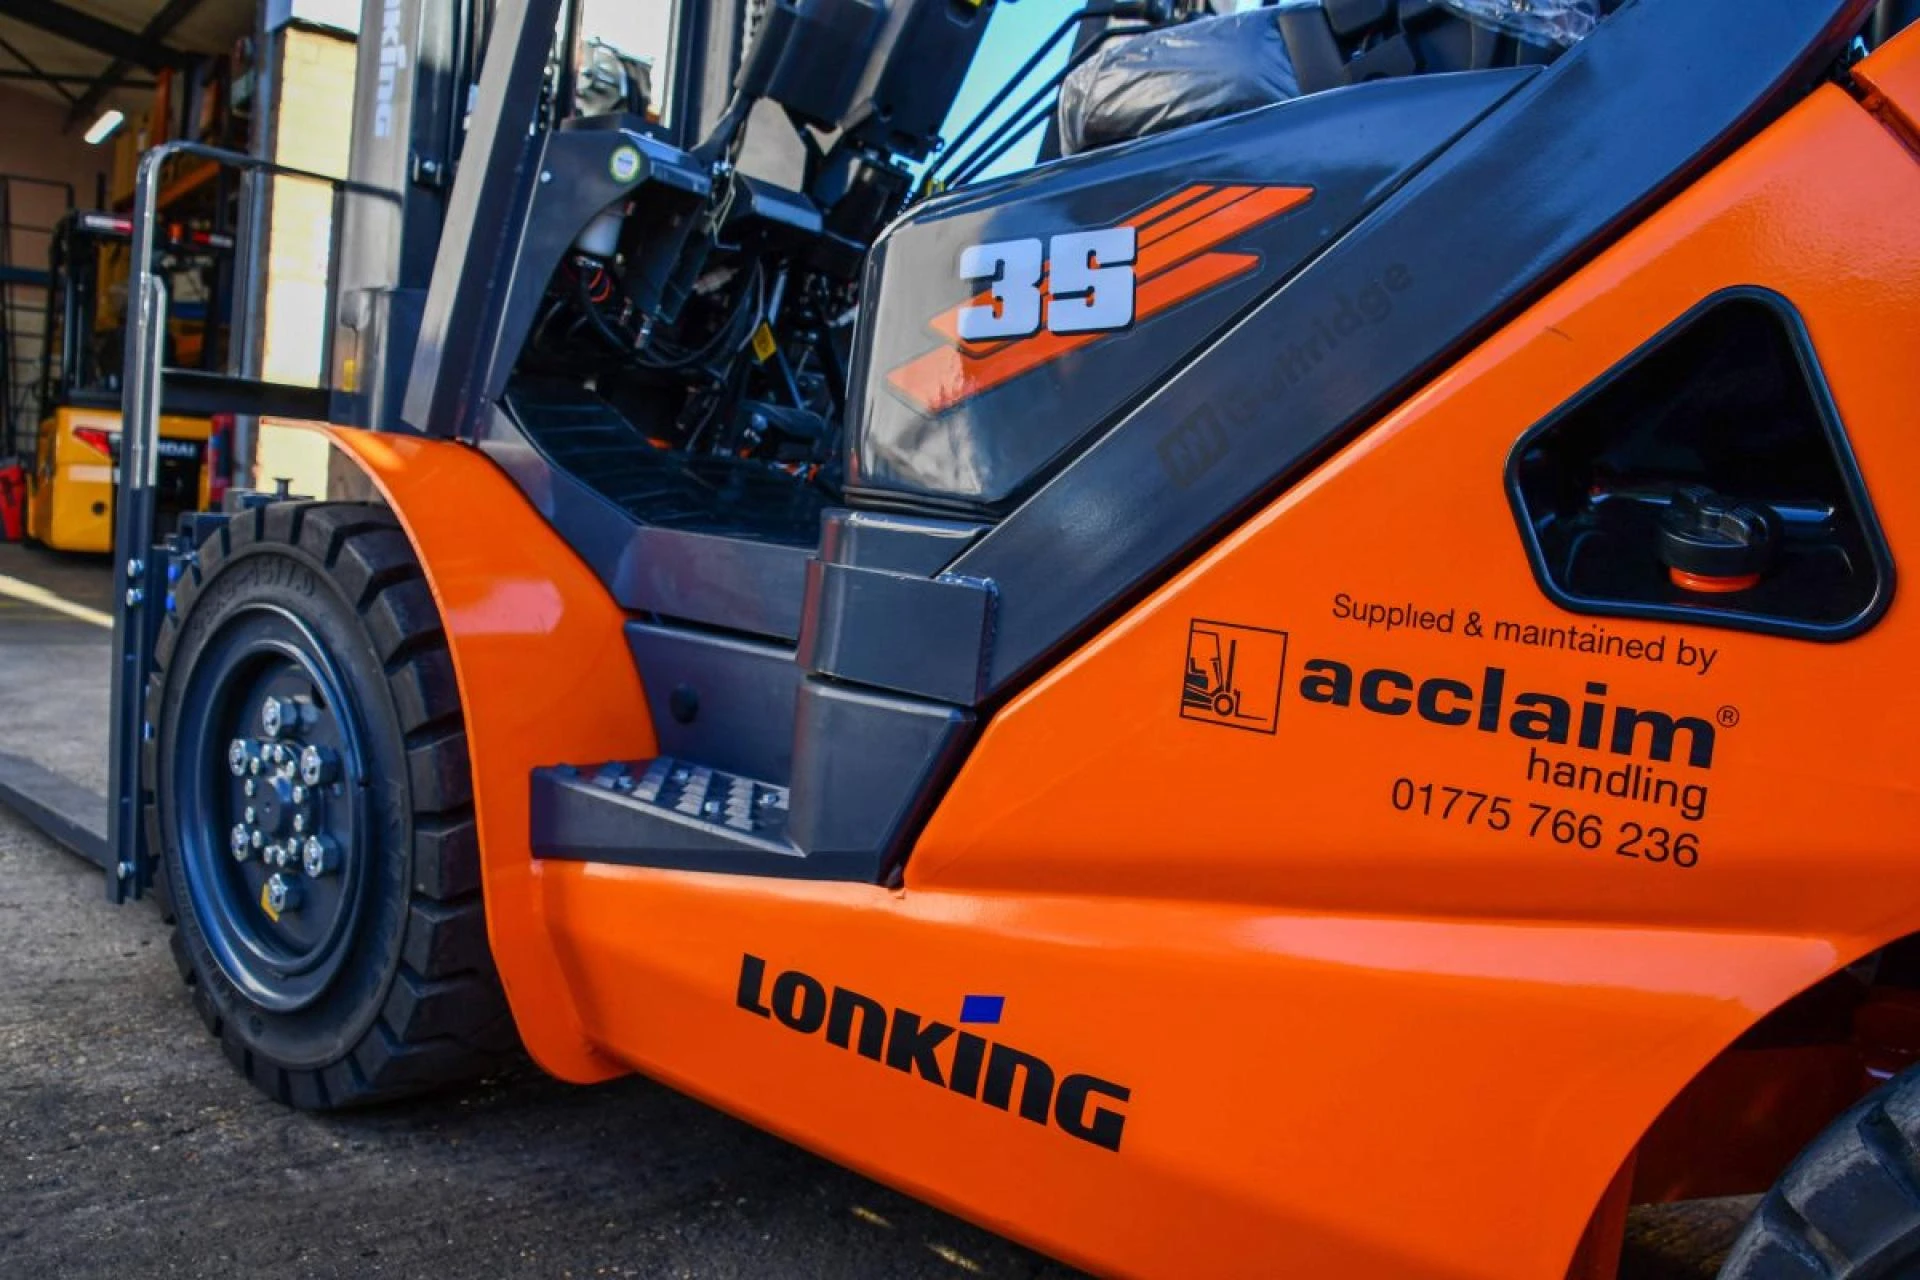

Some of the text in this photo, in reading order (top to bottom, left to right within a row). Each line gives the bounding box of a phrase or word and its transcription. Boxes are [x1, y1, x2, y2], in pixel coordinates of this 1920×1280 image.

[374, 0, 407, 137] KING
[957, 226, 1137, 343] 35
[1332, 593, 1718, 675] Supplied & maintained by
[1391, 778, 1700, 869] 01775 766 236
[1527, 748, 1708, 822] handling
